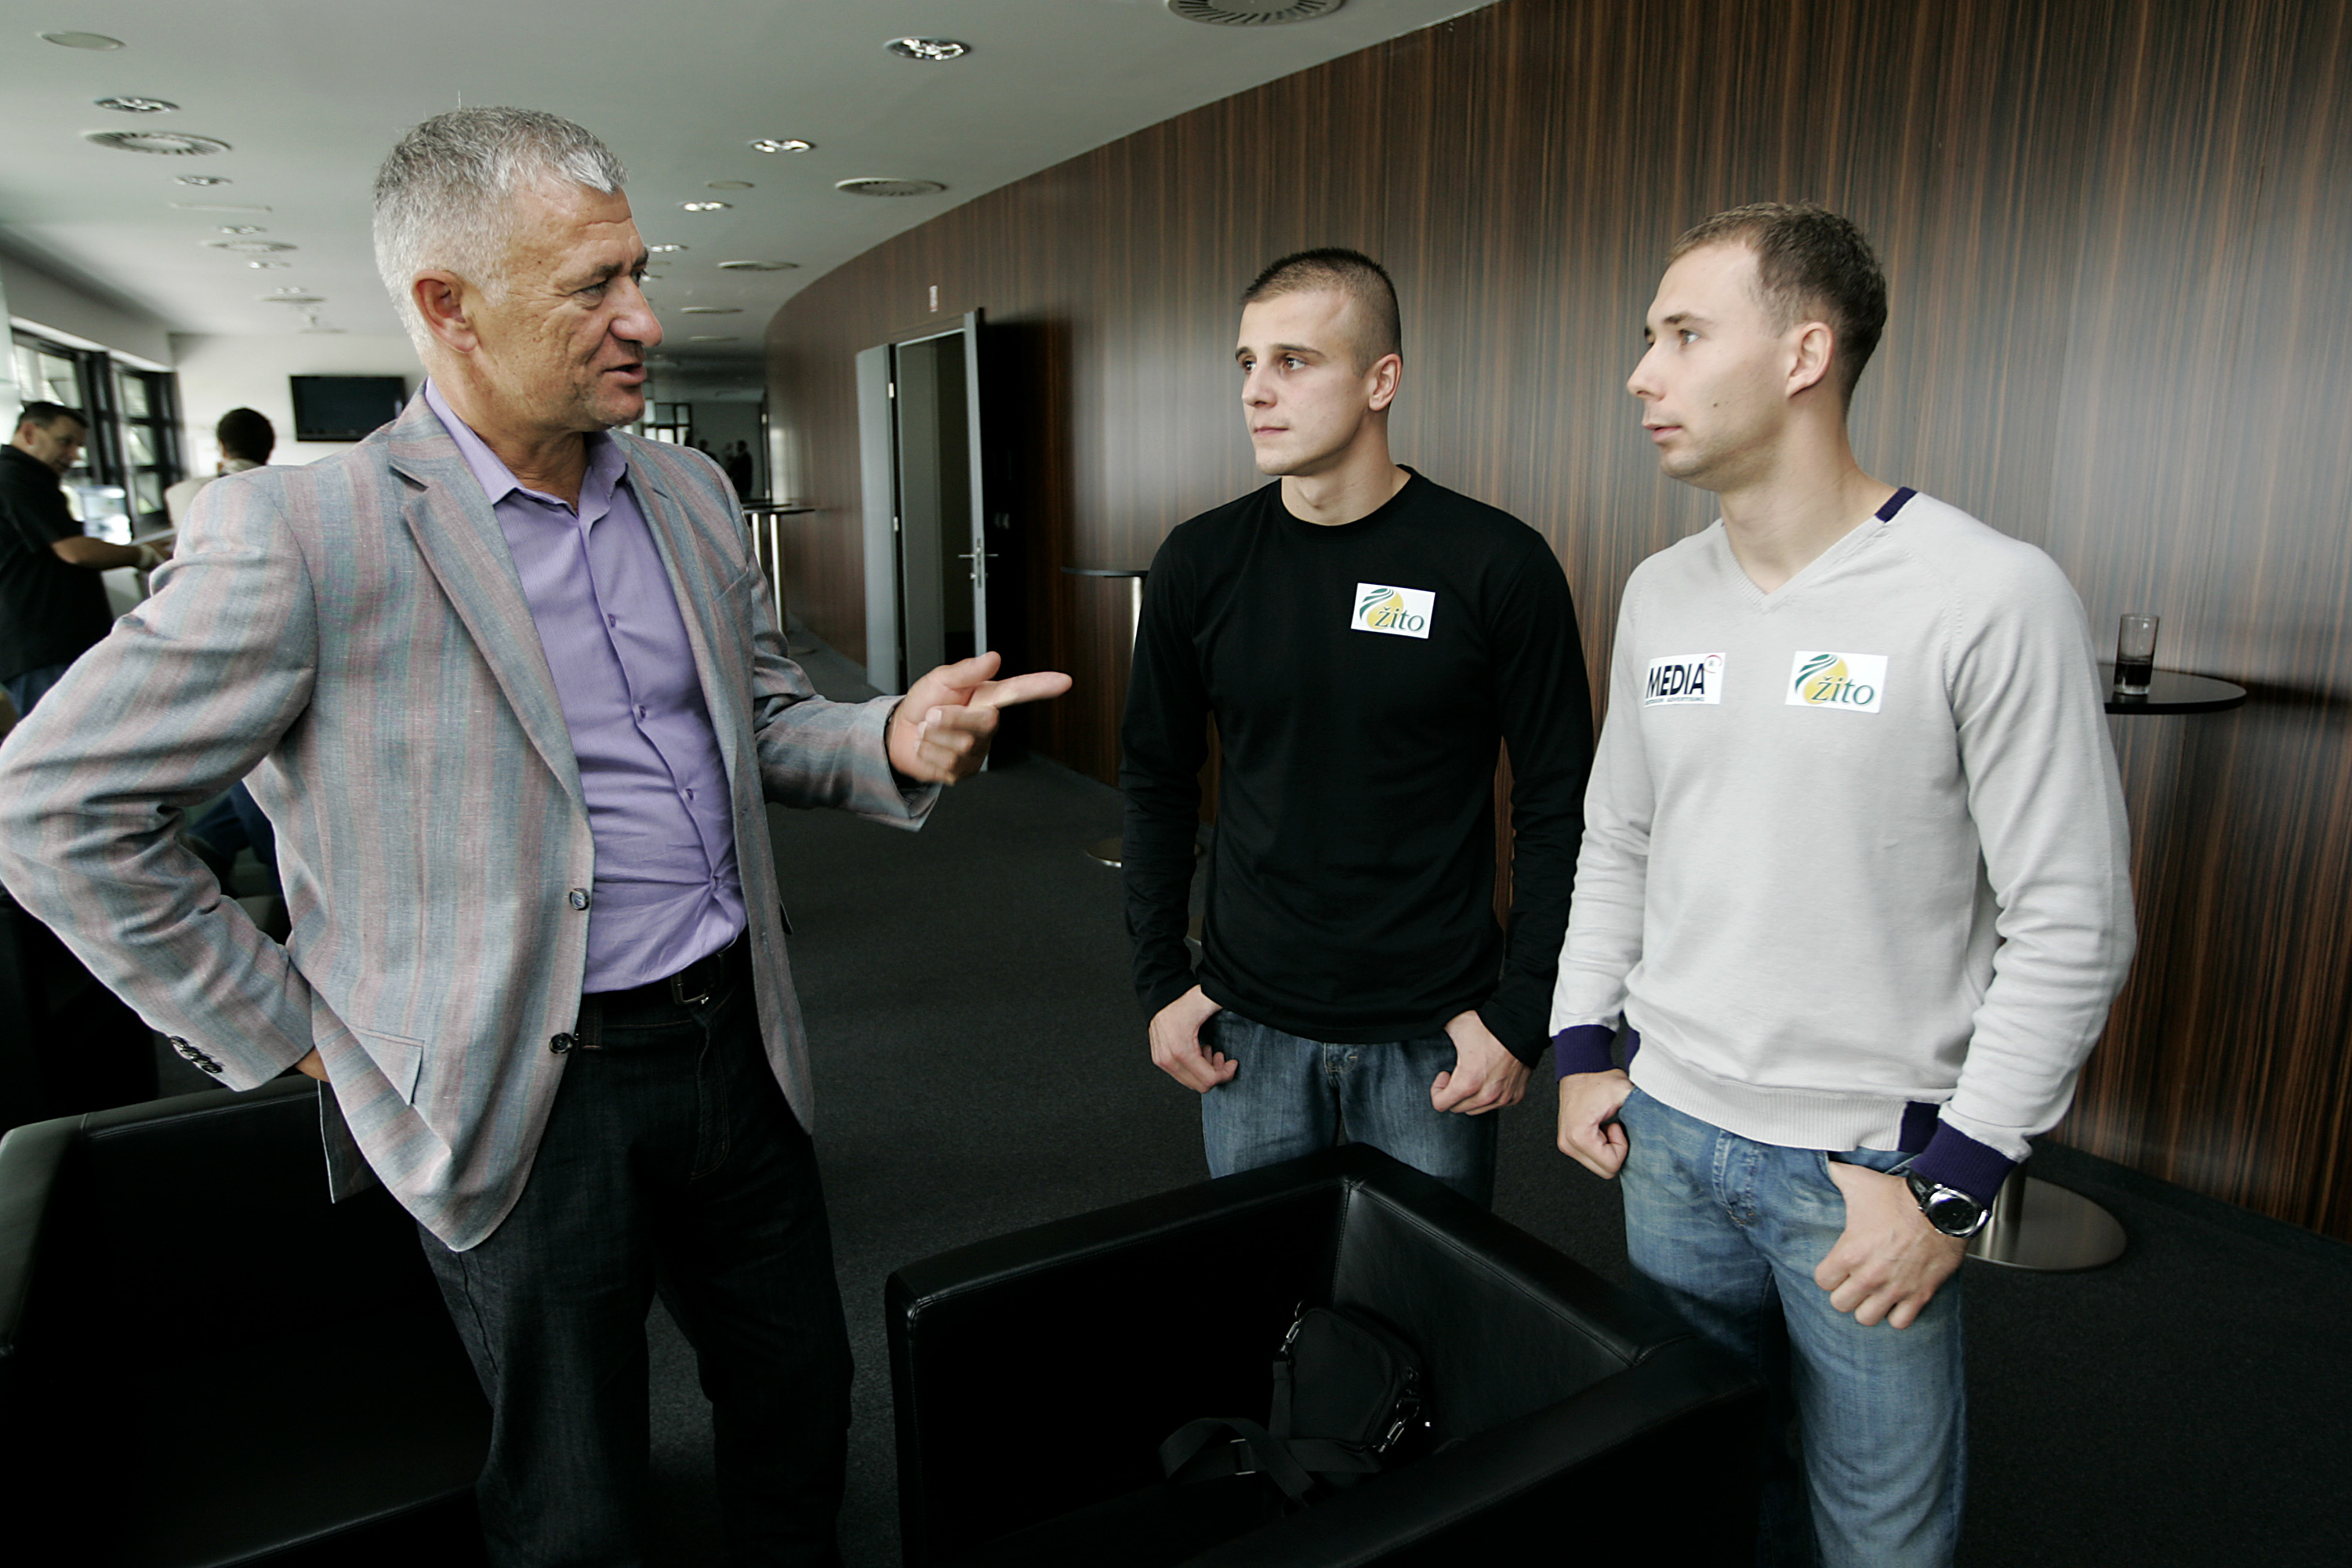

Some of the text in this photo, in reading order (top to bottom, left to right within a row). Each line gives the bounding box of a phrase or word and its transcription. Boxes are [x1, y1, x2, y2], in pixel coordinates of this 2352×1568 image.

[1374, 607, 1425, 632] žito
[1646, 662, 1705, 699] MEDIA
[1810, 677, 1875, 705] žito
